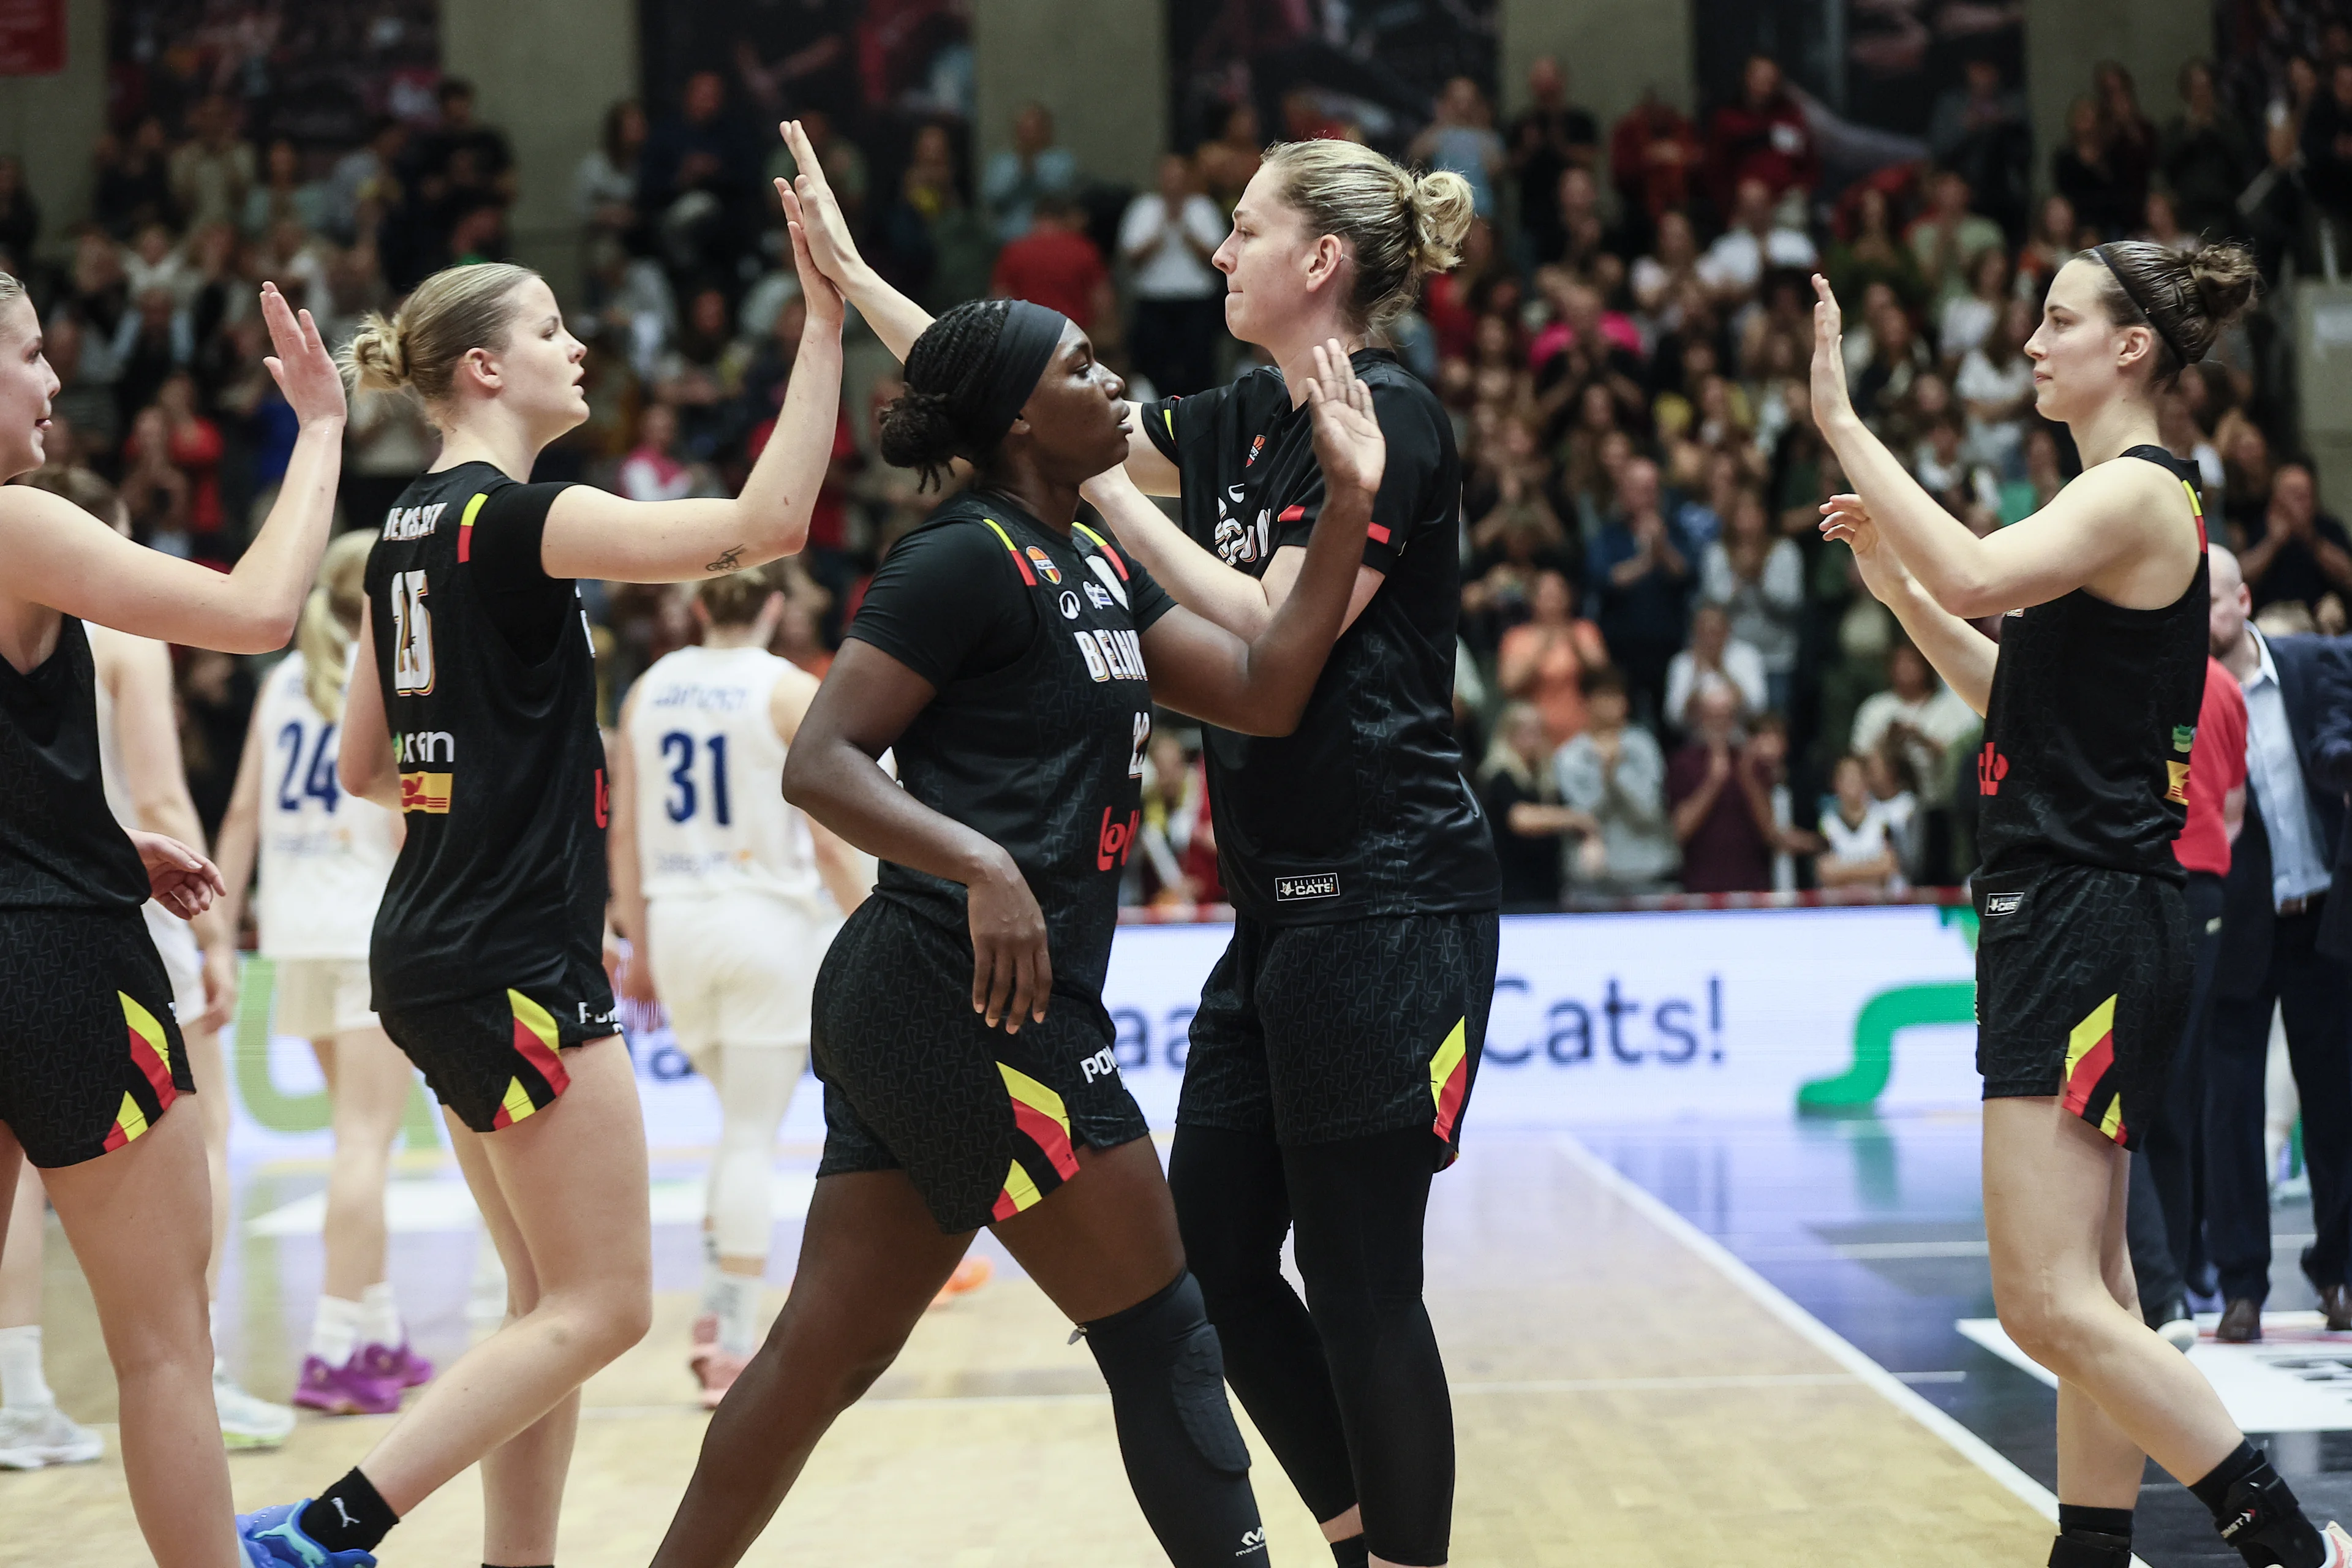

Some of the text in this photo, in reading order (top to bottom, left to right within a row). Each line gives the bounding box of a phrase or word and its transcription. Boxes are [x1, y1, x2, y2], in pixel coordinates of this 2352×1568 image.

[277, 722, 340, 814] 24
[660, 732, 732, 826] 31
[1295, 883, 1331, 895] CATS
[1482, 975, 1723, 1065] Cats!
